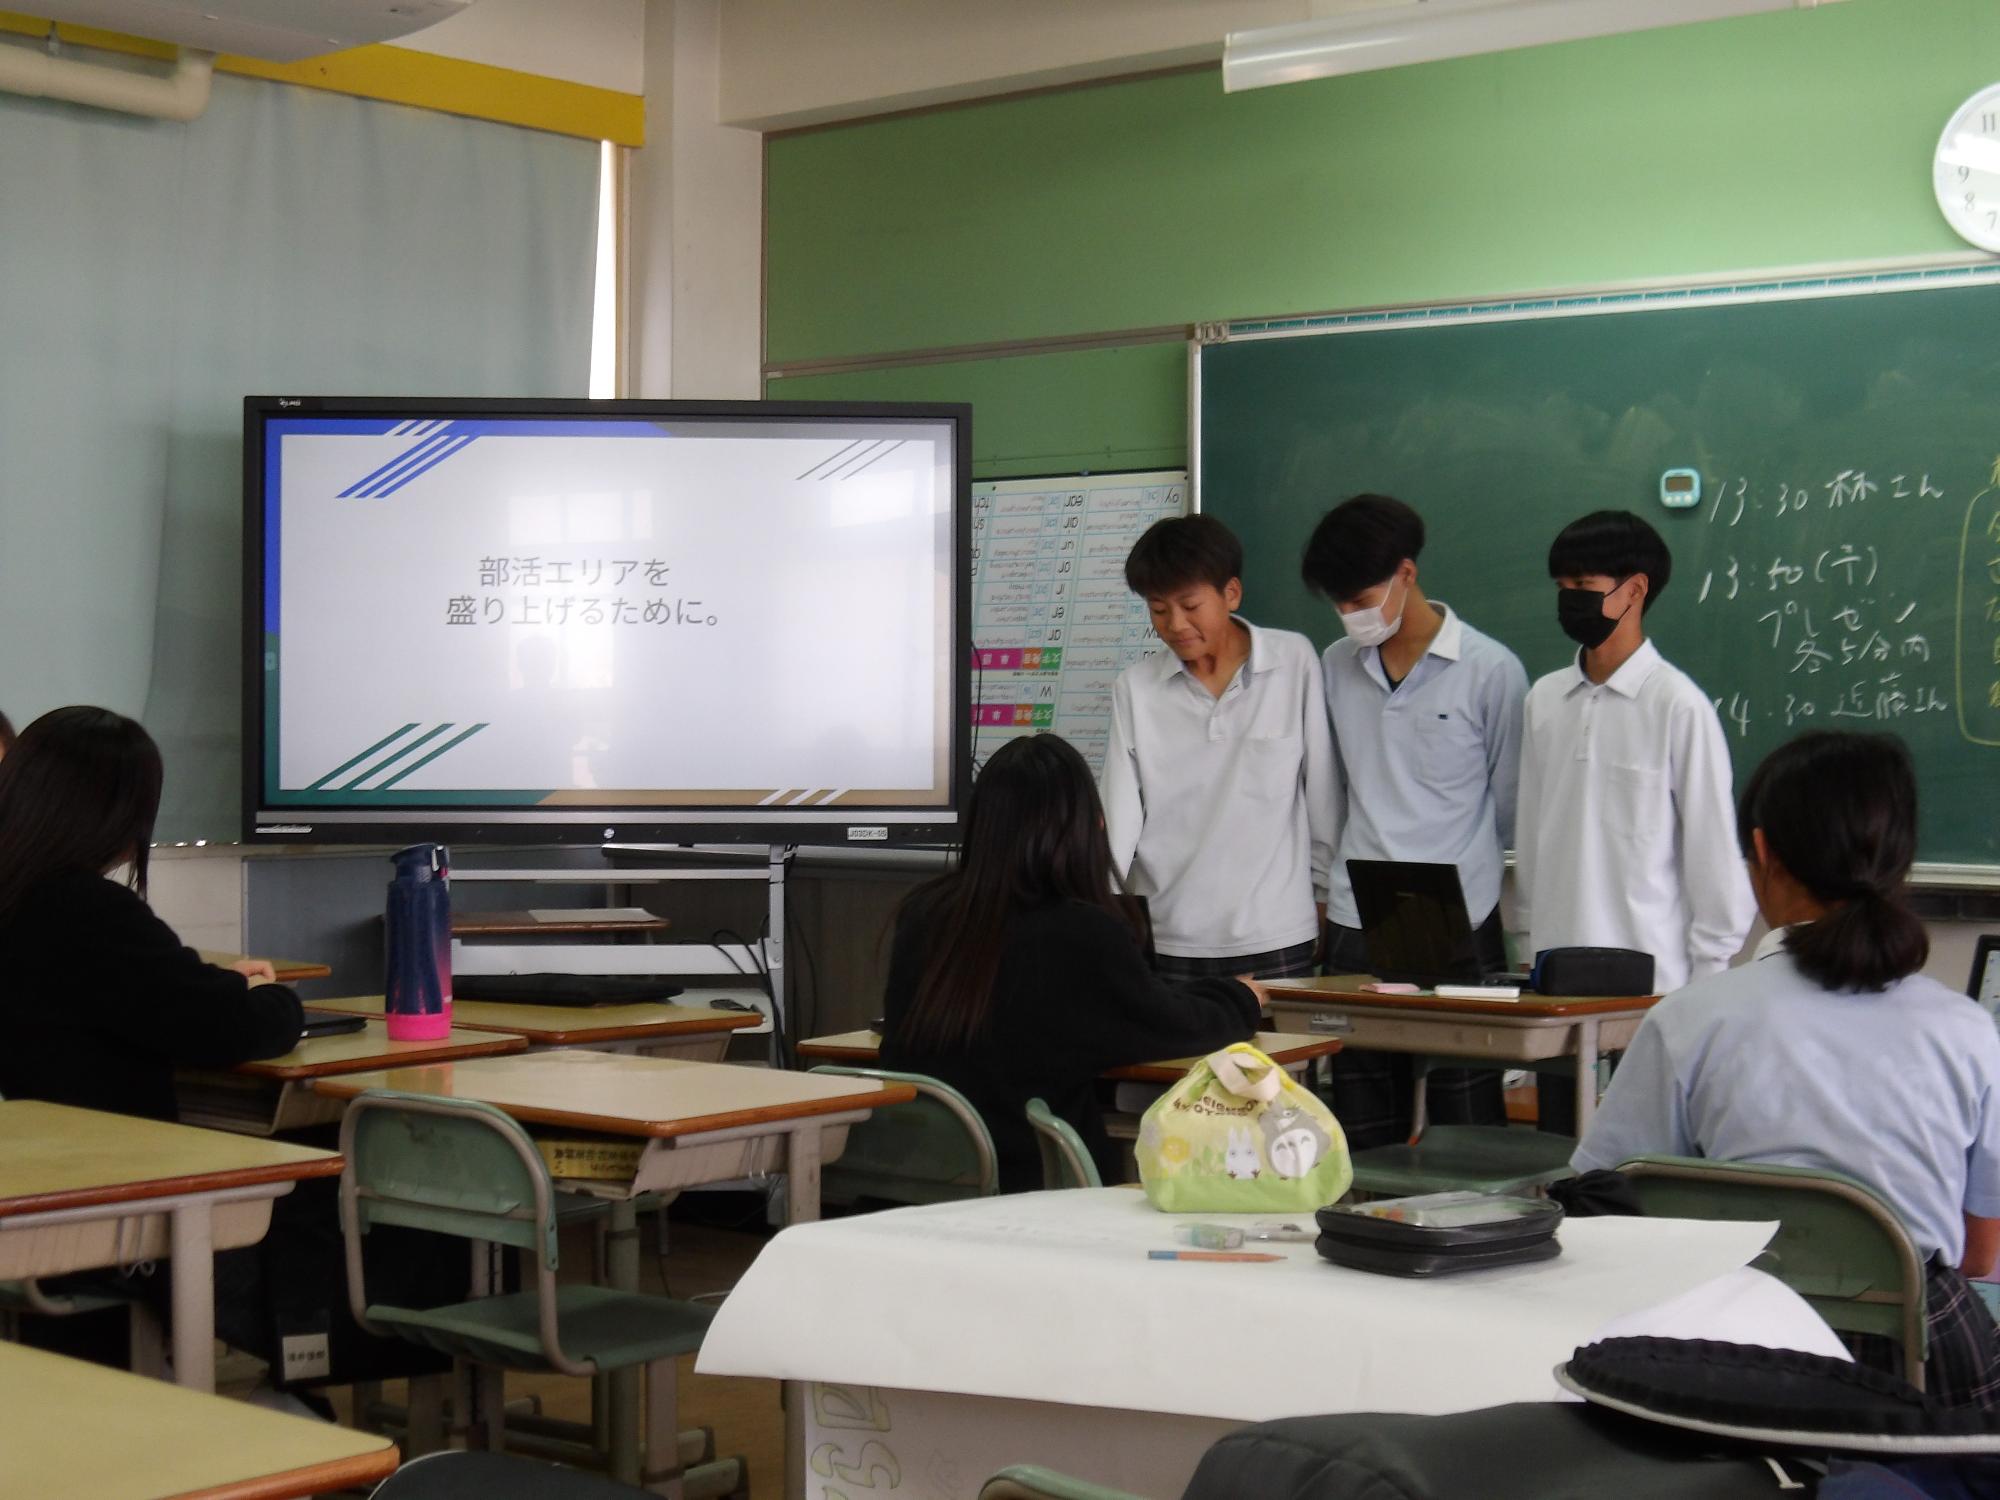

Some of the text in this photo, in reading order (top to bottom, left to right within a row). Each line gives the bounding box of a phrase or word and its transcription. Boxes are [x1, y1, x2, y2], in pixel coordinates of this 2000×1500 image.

[1981, 112, 1996, 134] 11
[1957, 165, 1970, 183] 9
[1963, 192, 1976, 212] 8
[1986, 211, 1998, 232] 7
[478, 556, 670, 587] 部活エリアを
[446, 595, 719, 626] 盛り上げるために。
